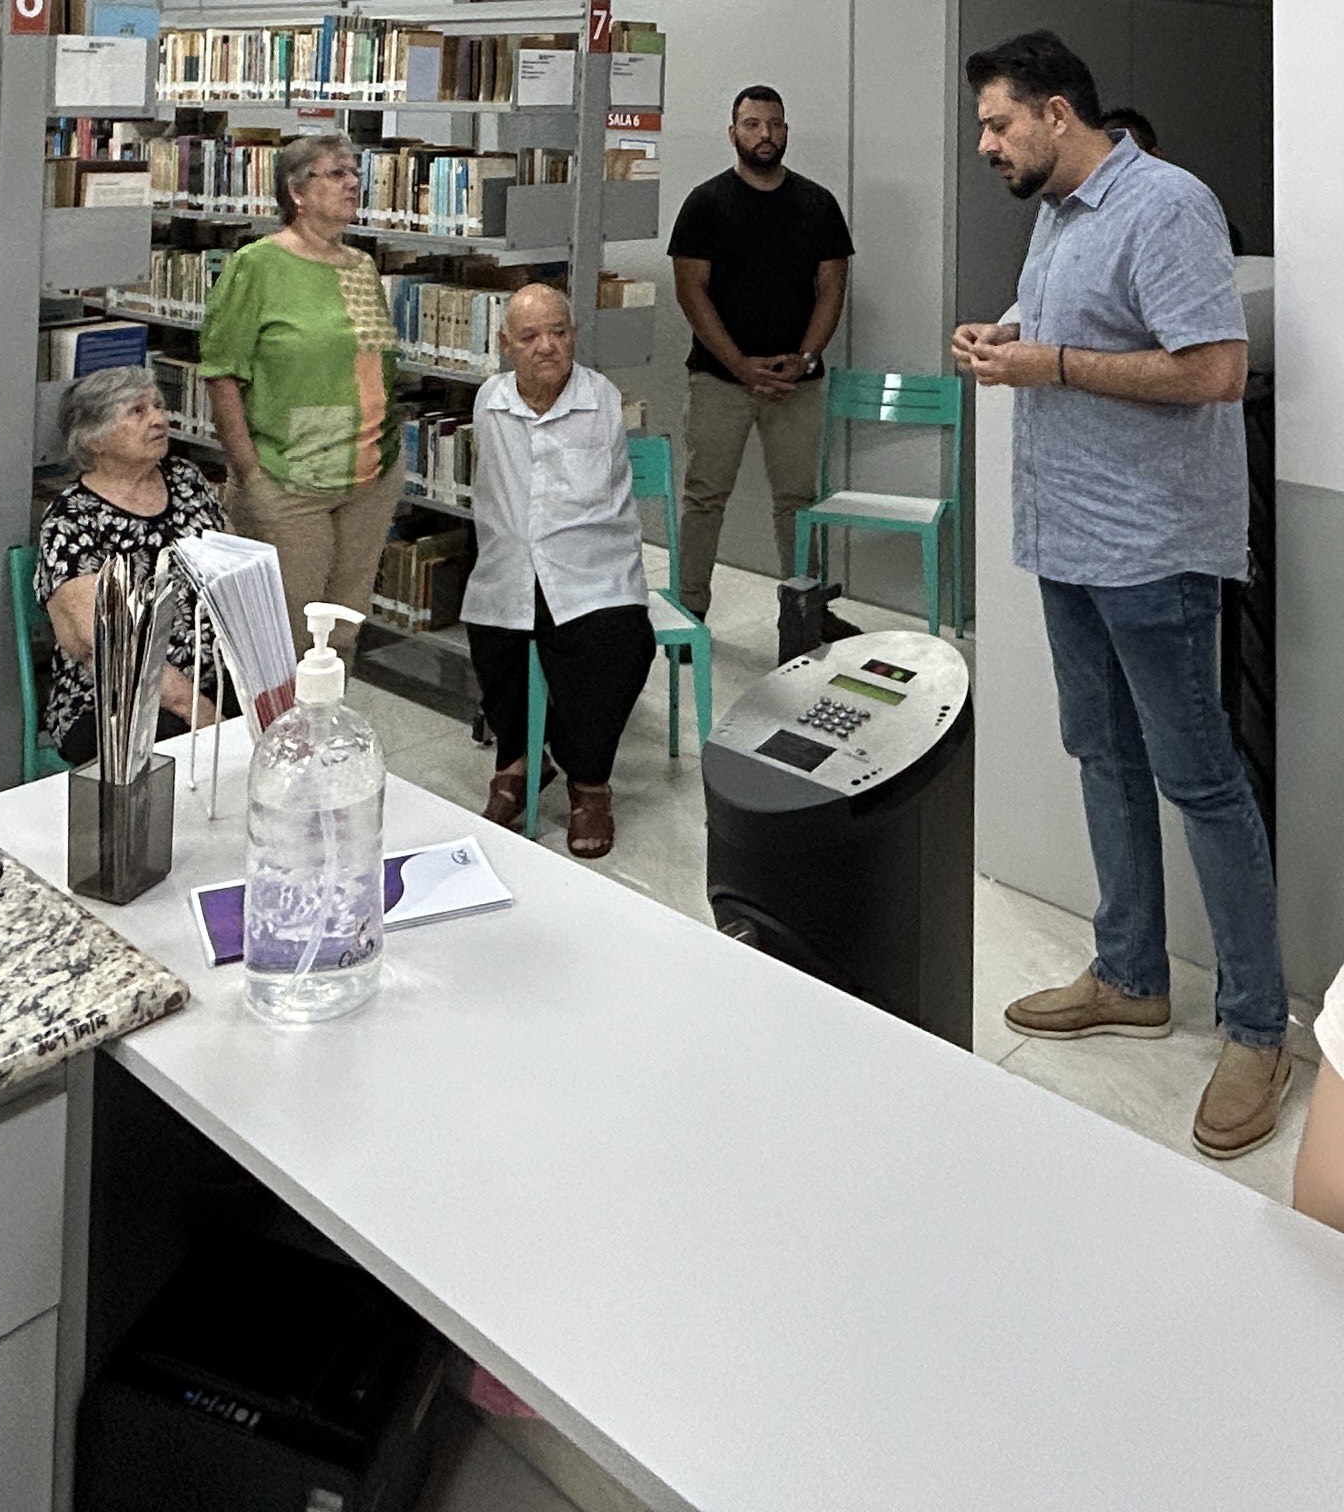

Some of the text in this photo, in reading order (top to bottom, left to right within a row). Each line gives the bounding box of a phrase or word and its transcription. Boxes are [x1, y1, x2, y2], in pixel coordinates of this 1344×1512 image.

[592, 9, 607, 41] 7
[607, 113, 640, 127] SALA 6
